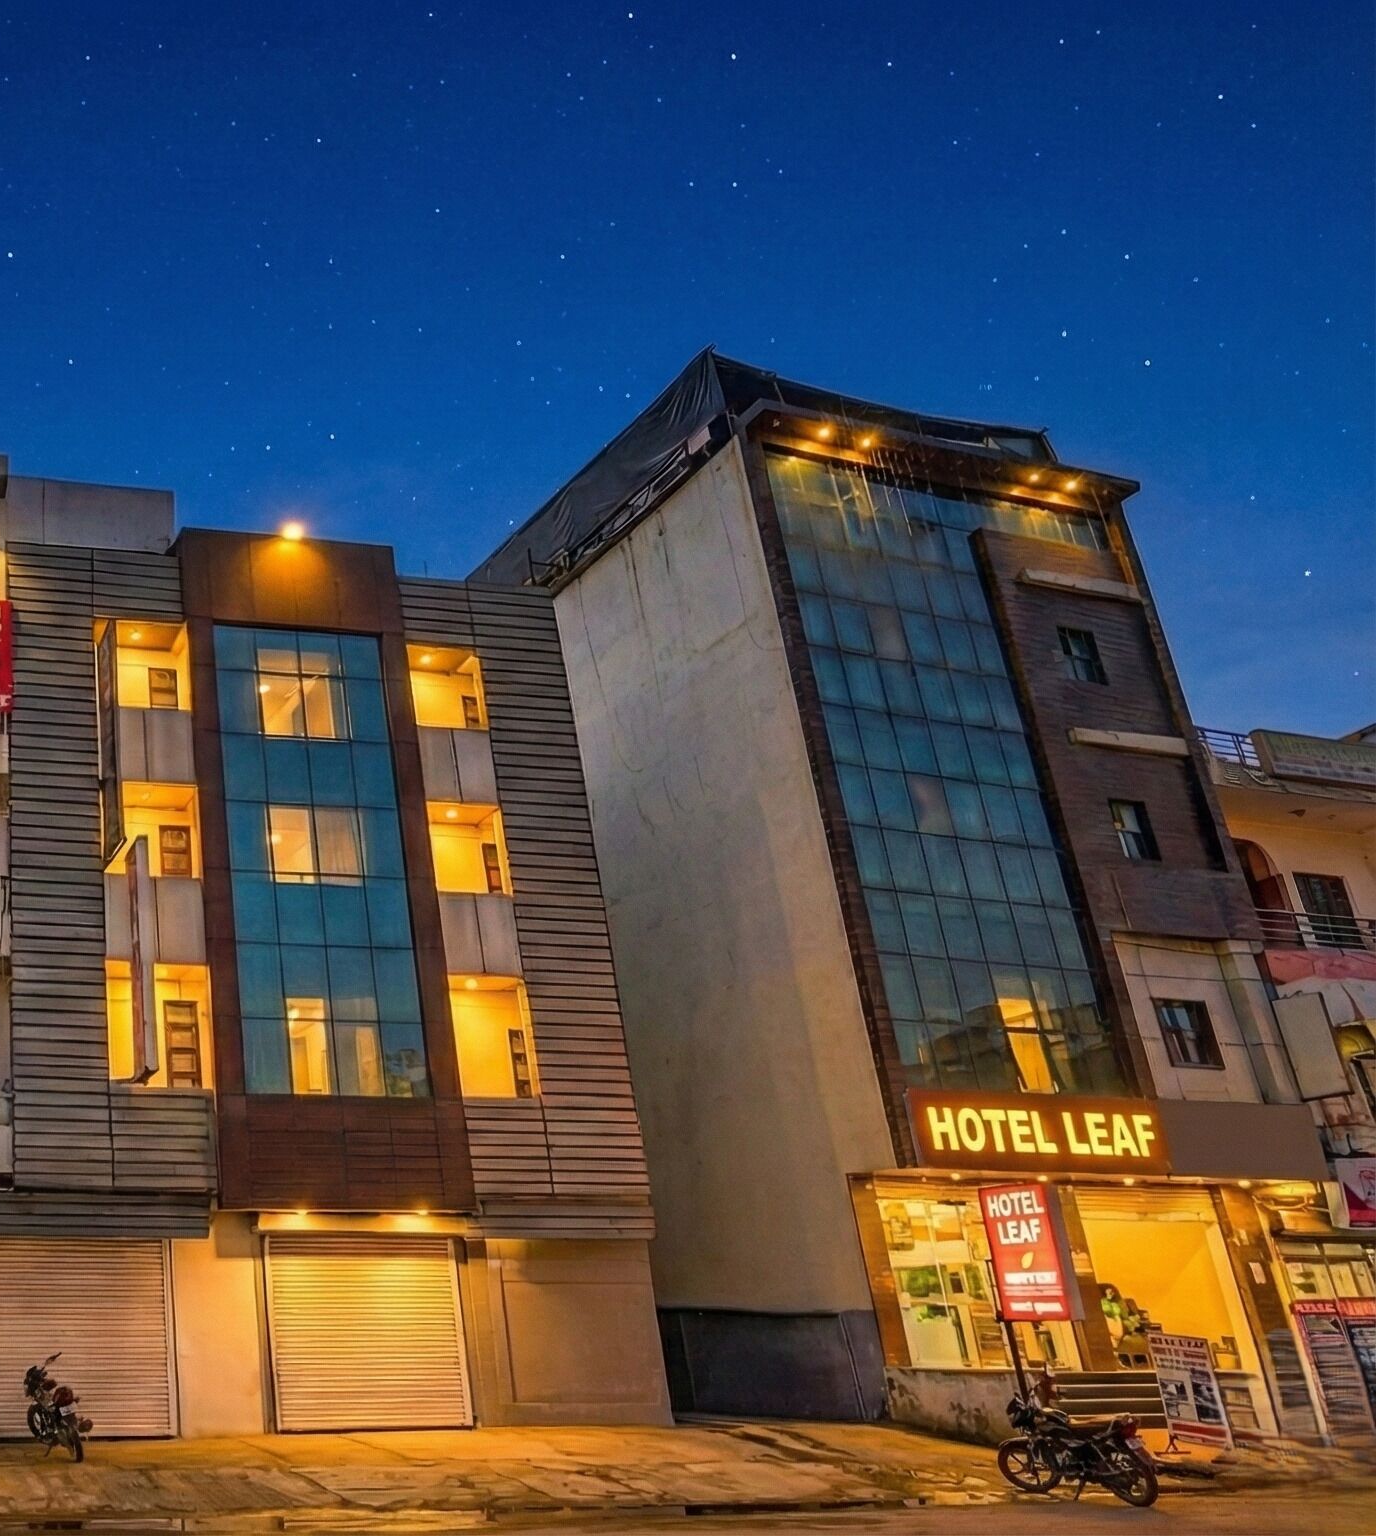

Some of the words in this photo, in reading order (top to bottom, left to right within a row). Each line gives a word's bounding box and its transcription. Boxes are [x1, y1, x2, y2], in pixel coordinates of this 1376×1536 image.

[926, 1105, 1059, 1154] HOTEL
[1060, 1110, 1155, 1158] LEAF
[986, 1190, 1045, 1218] HOTEL
[996, 1218, 1041, 1245] LEAF
